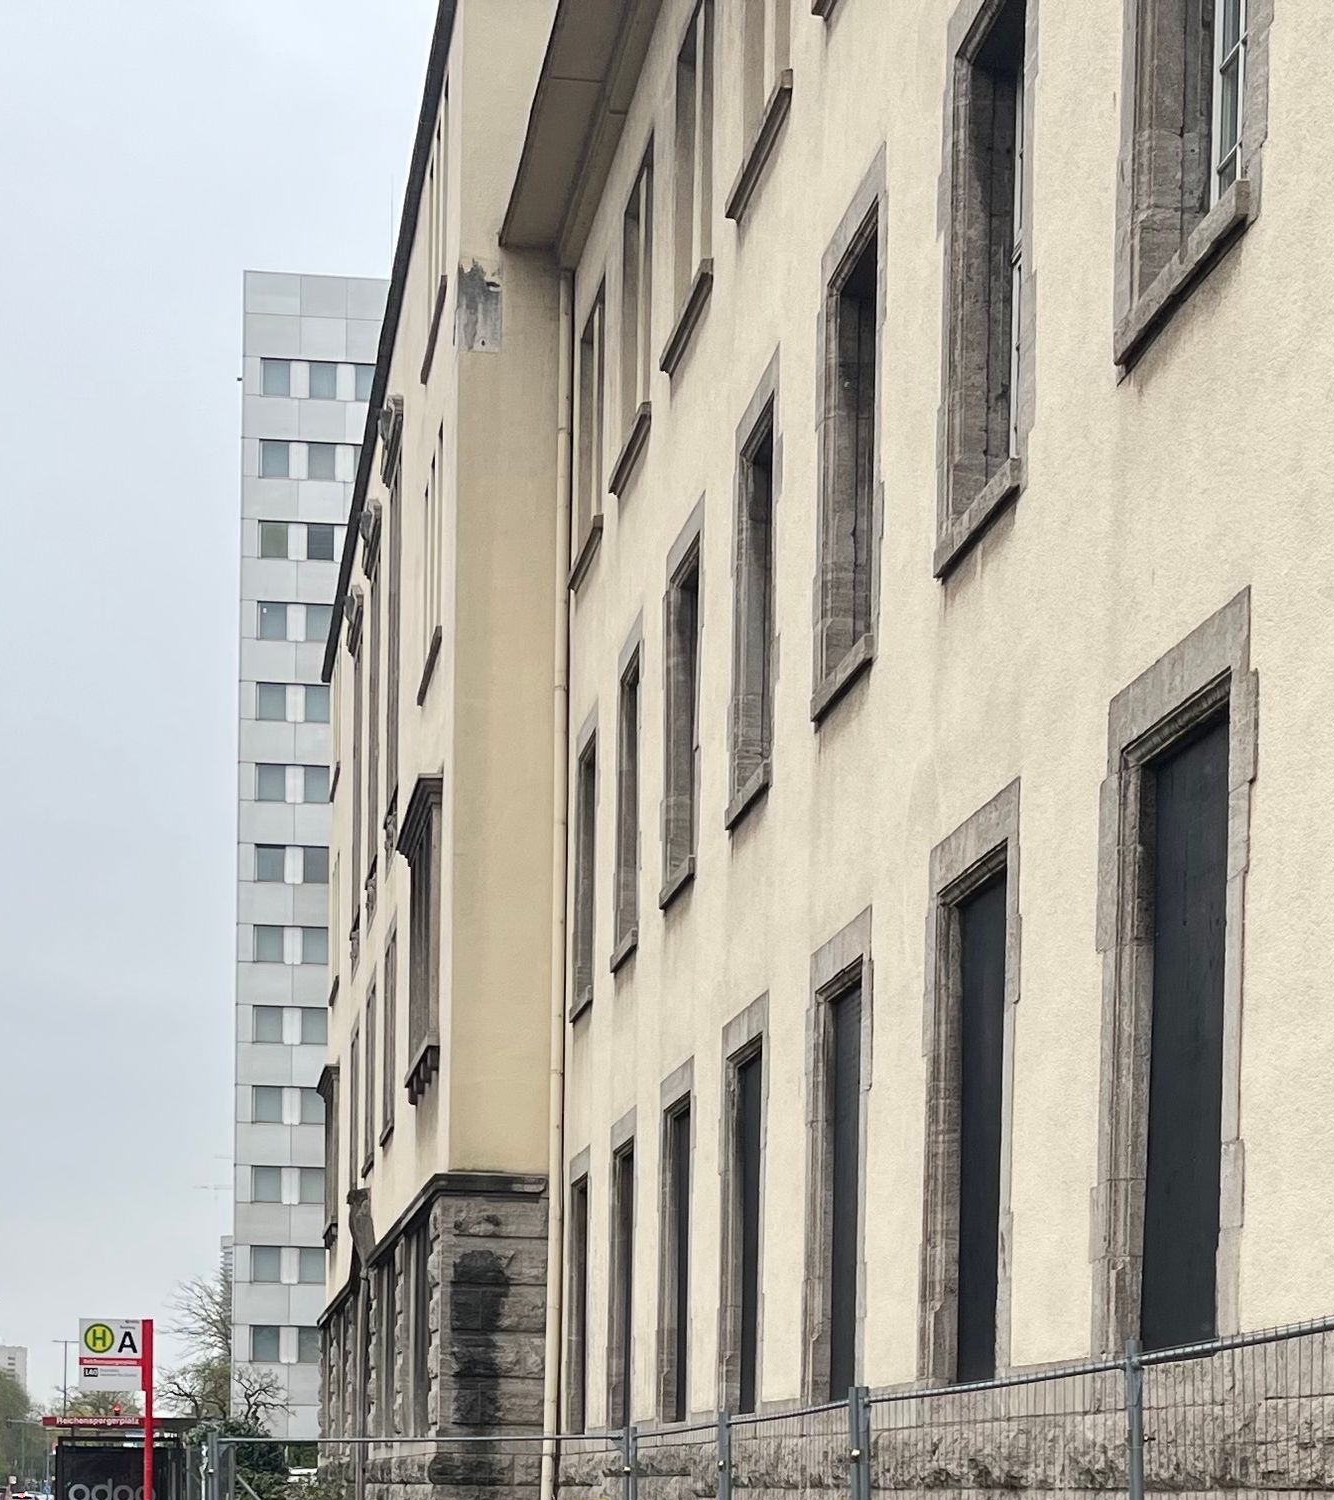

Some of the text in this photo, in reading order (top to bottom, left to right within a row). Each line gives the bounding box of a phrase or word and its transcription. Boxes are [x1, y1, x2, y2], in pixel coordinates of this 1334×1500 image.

[92, 1328, 106, 1347] H
[117, 1331, 138, 1353] A
[56, 1417, 140, 1426] Reichenspergerplatz
